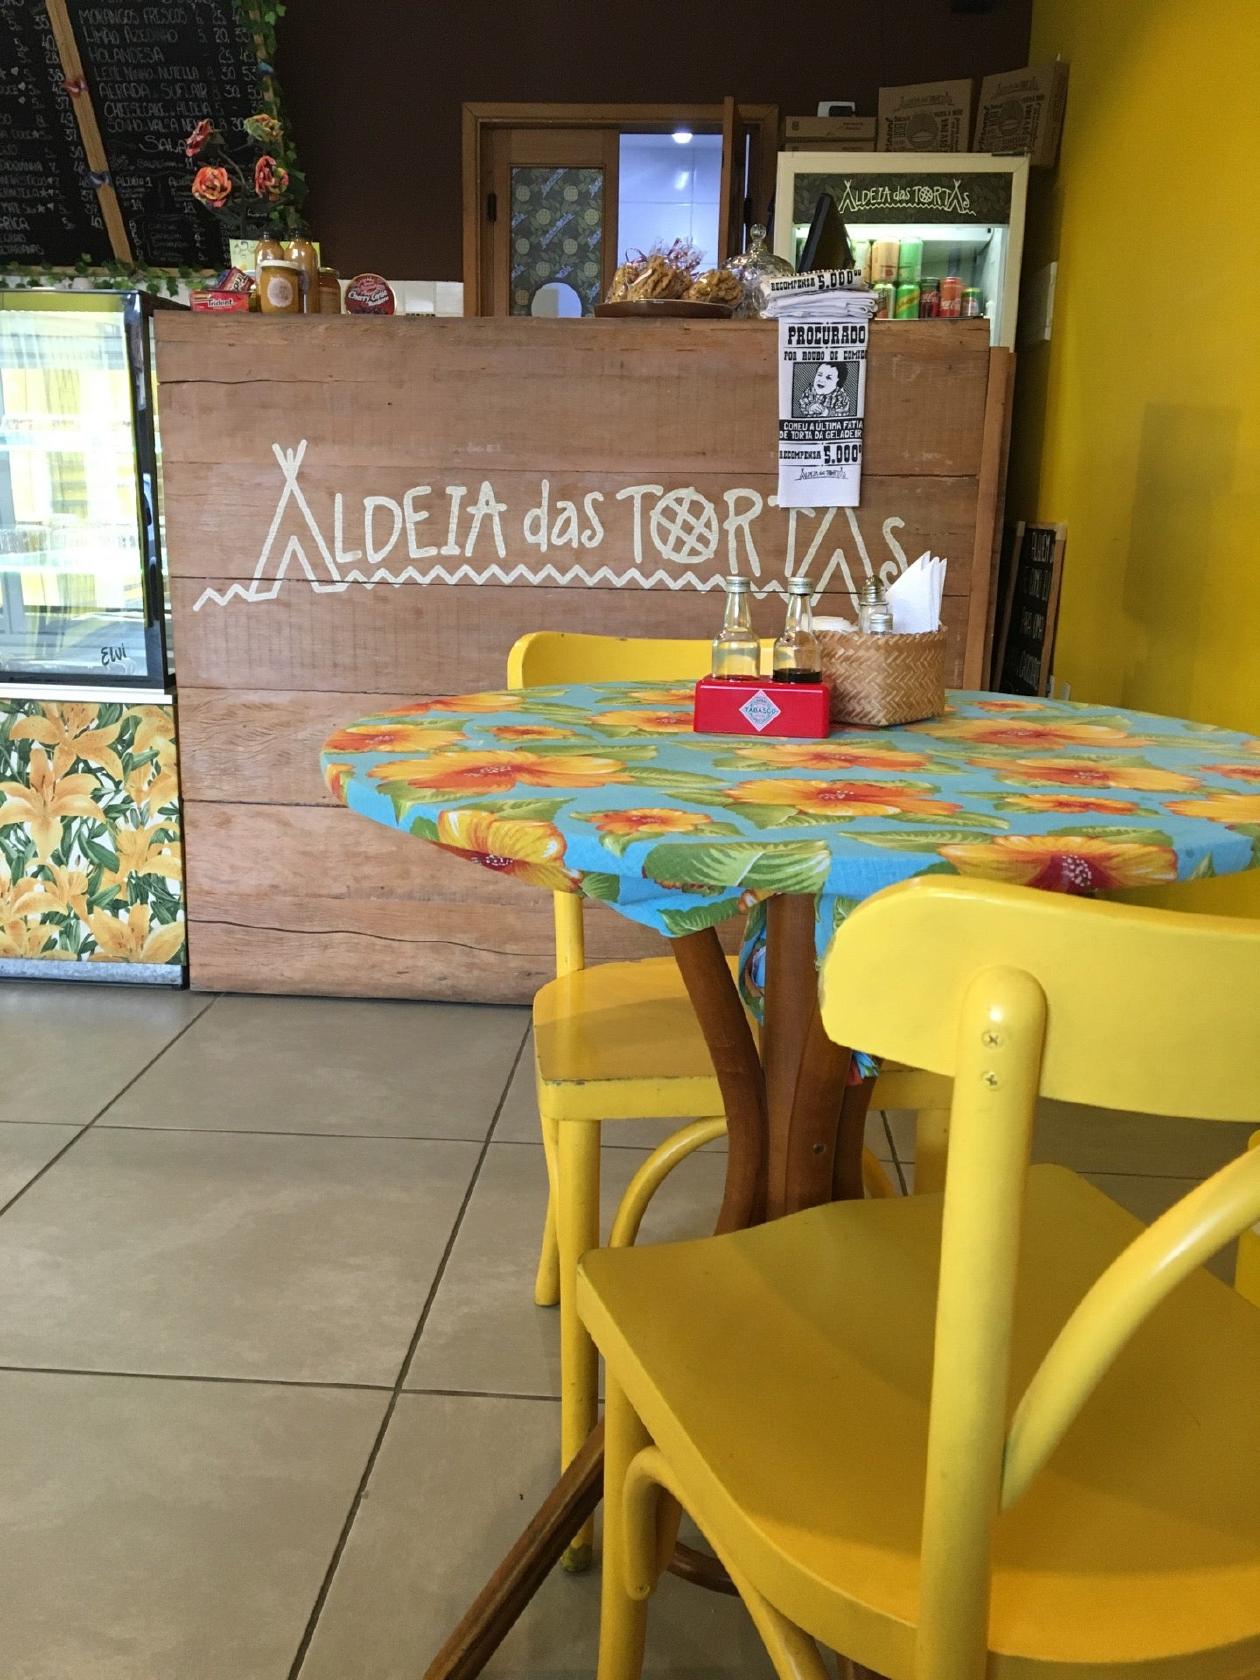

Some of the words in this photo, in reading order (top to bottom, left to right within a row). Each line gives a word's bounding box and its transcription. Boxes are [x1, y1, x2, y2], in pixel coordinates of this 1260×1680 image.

[893, 185, 911, 201] das
[787, 325, 866, 345] PROCURADO
[783, 351, 797, 361] POR
[801, 350, 825, 361] ROUBO
[783, 421, 808, 431] COMEU
[808, 421, 815, 431] A
[842, 419, 864, 430] FATIA
[790, 430, 813, 440] TORTA
[814, 430, 824, 440] DA
[523, 479, 605, 553] das
